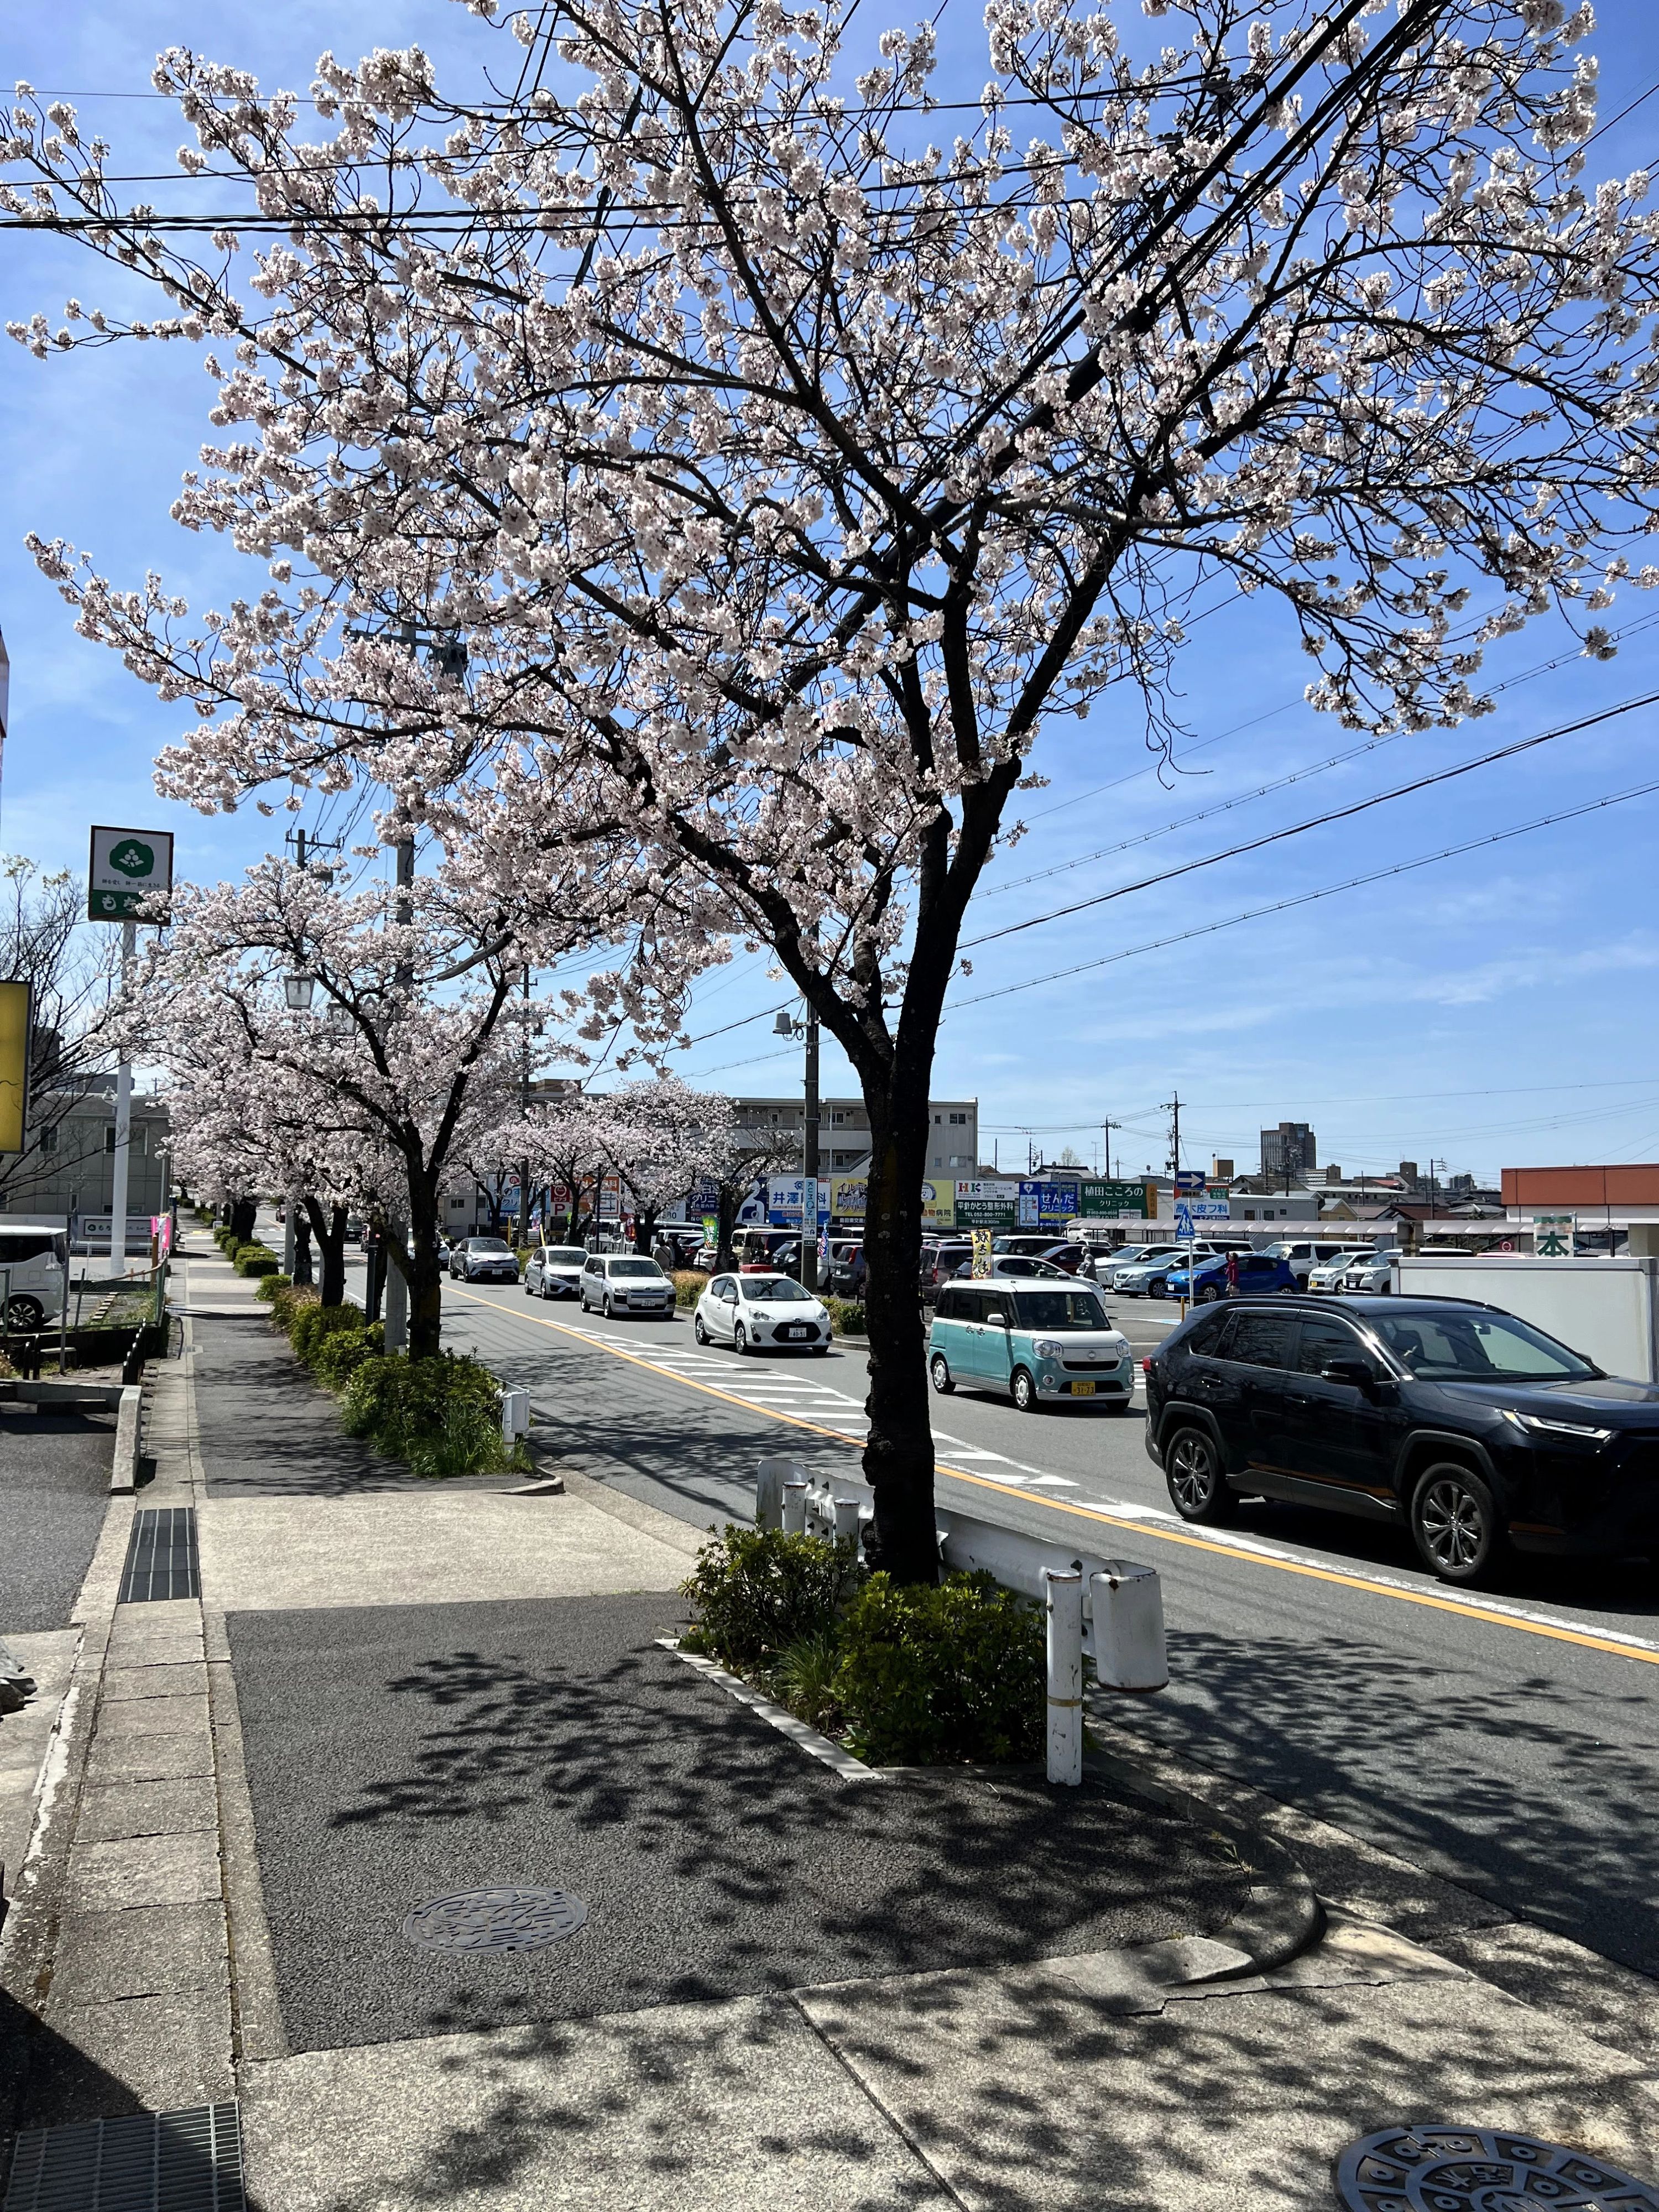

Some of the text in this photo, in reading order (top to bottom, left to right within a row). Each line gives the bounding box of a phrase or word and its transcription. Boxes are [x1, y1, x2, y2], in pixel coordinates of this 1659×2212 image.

[102, 894, 136, 912] もち
[1084, 1186, 1143, 1197] 植田こころの
[806, 1182, 815, 1215] KUMON
[1041, 1194, 1074, 1204] せんだ
[555, 1204, 565, 1215] P
[958, 1202, 1013, 1211] 平針かとう整形外科
[1537, 1231, 1570, 1257] 本
